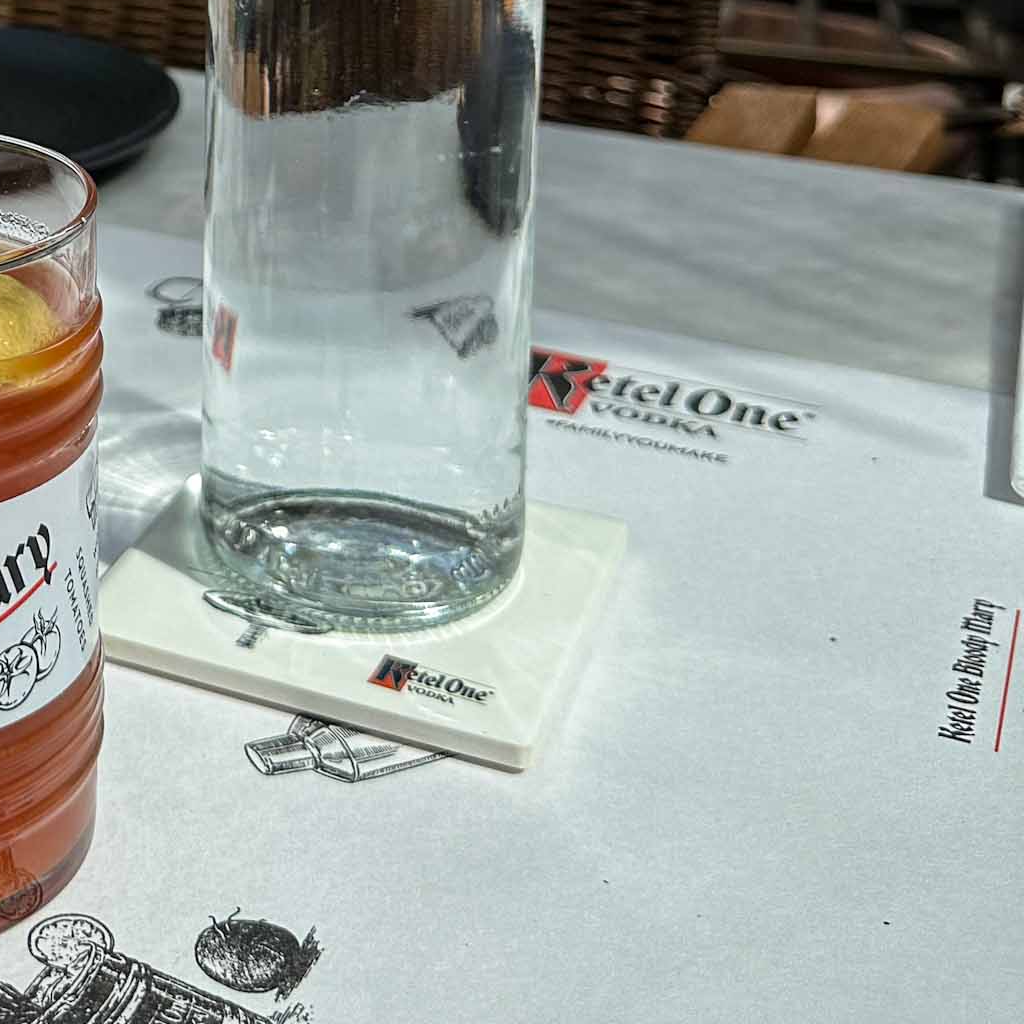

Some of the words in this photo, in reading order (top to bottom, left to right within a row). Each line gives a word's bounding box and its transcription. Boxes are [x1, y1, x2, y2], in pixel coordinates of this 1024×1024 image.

[590, 400, 718, 438] VODKA
[44, 567, 87, 652] TOMATOES
[960, 598, 1007, 635] Mary
[952, 634, 1000, 678] Bloody
[407, 684, 456, 705] VODKA
[945, 677, 983, 705] One
[938, 705, 977, 744] Ketel
